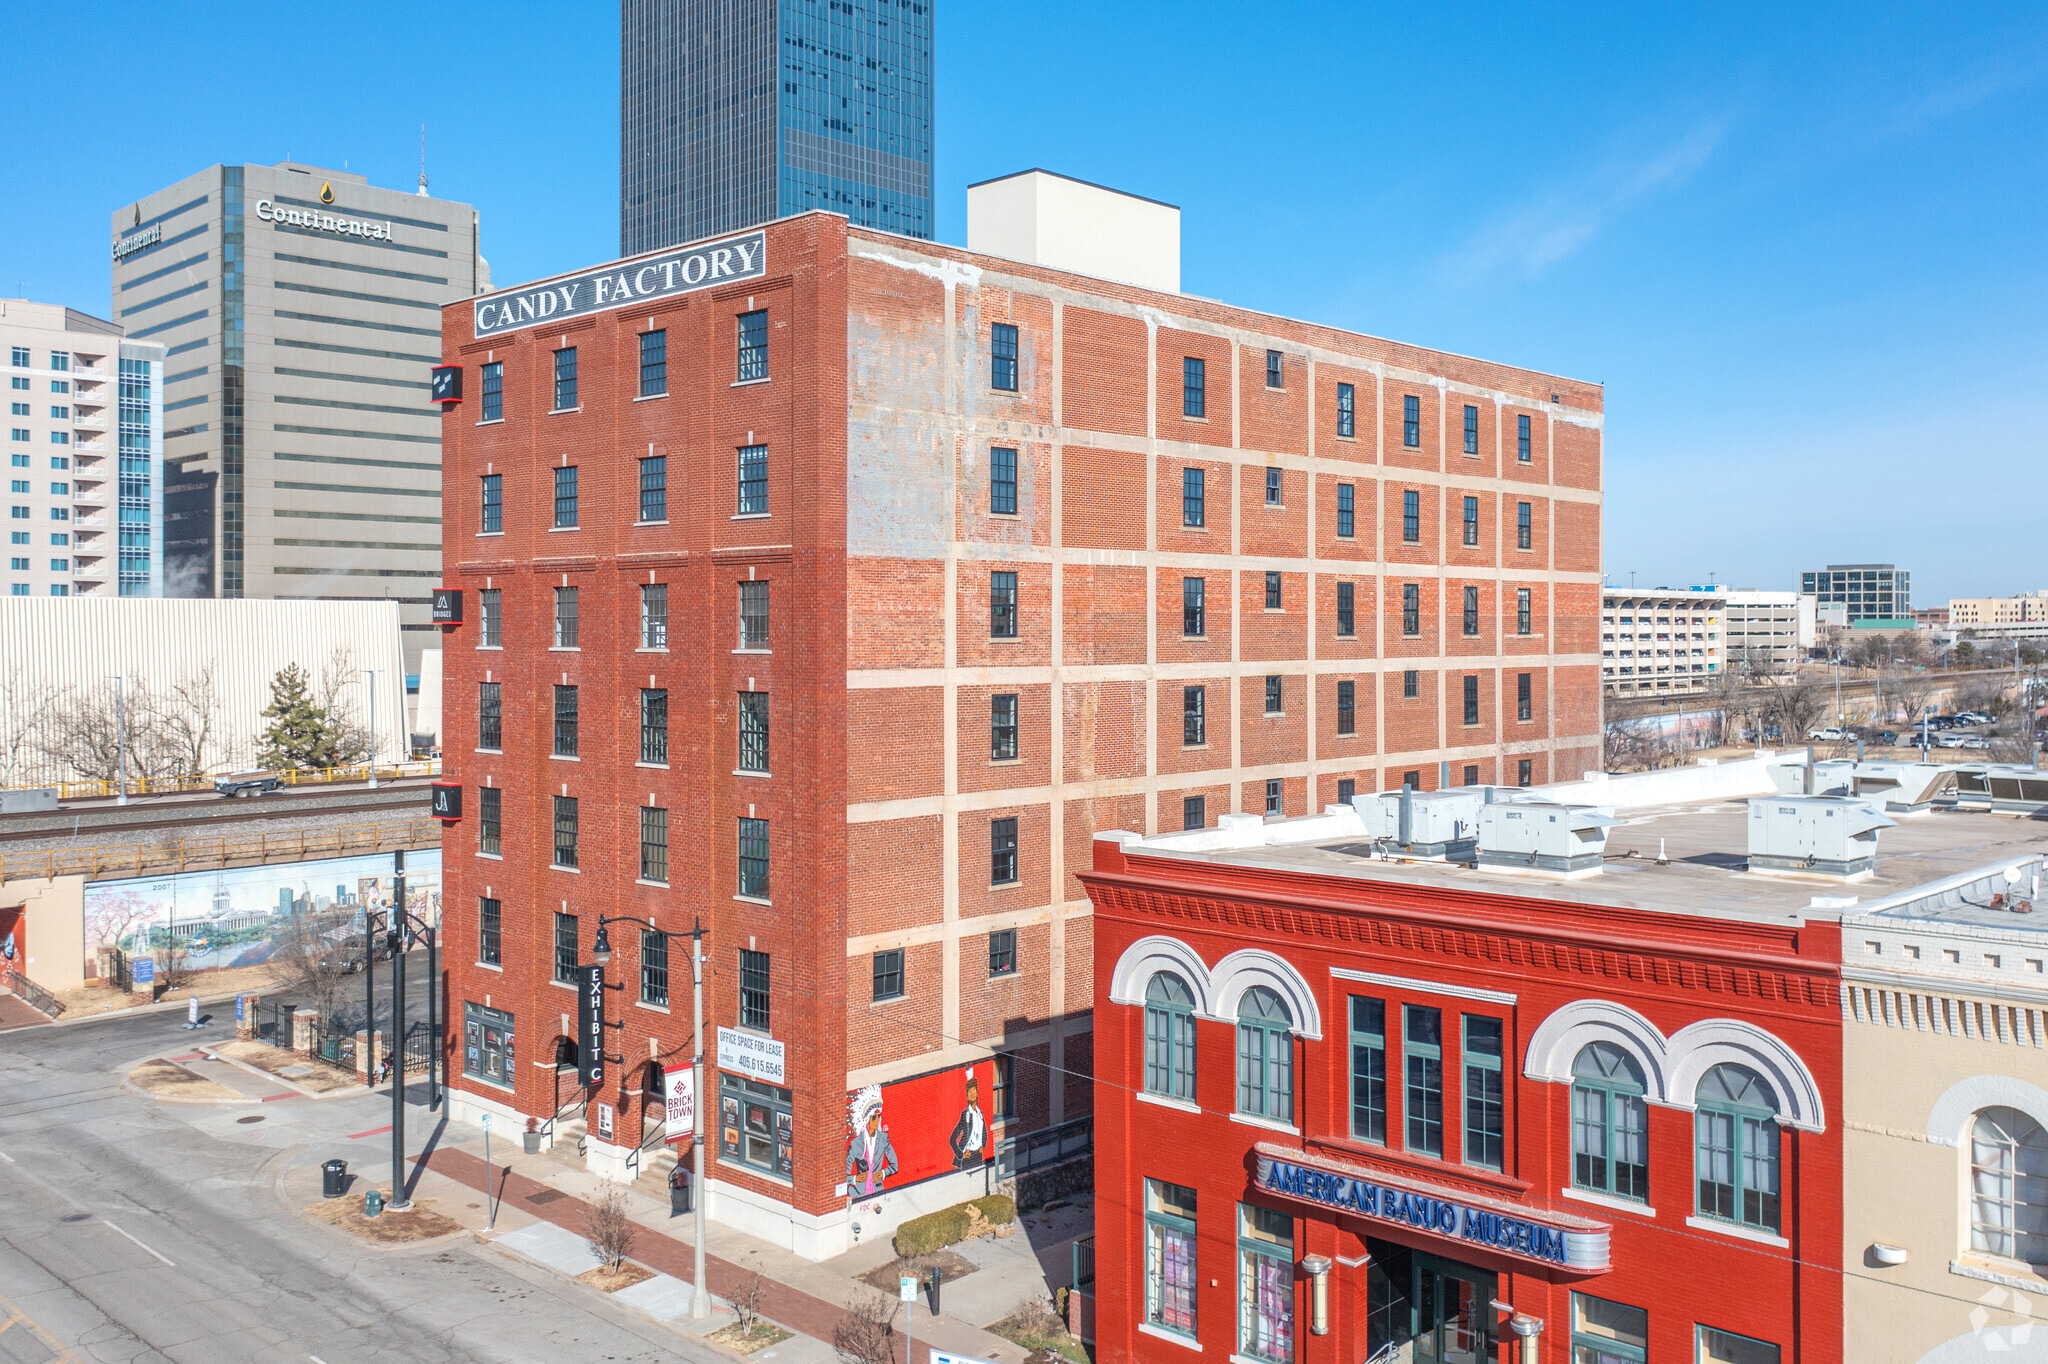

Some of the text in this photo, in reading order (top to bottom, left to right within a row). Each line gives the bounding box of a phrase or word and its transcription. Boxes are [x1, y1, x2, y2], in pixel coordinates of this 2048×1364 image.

[256, 200, 393, 241] Continental
[112, 223, 161, 260] Continental
[477, 240, 762, 330] CANDY FACTORY
[433, 610, 451, 618] BRIDGES
[153, 883, 171, 891] 2007
[590, 968, 602, 1081] EXHIBIT C
[720, 1031, 782, 1057] OFFICE SPACE FOR LEASE
[739, 1055, 782, 1077] 405.615.6545
[668, 1093, 692, 1109] BRICK
[668, 1105, 692, 1121] TOWN
[859, 1203, 871, 1213] FDC
[1266, 1160, 1569, 1264] AMERICAN BANJO MUSEUM
